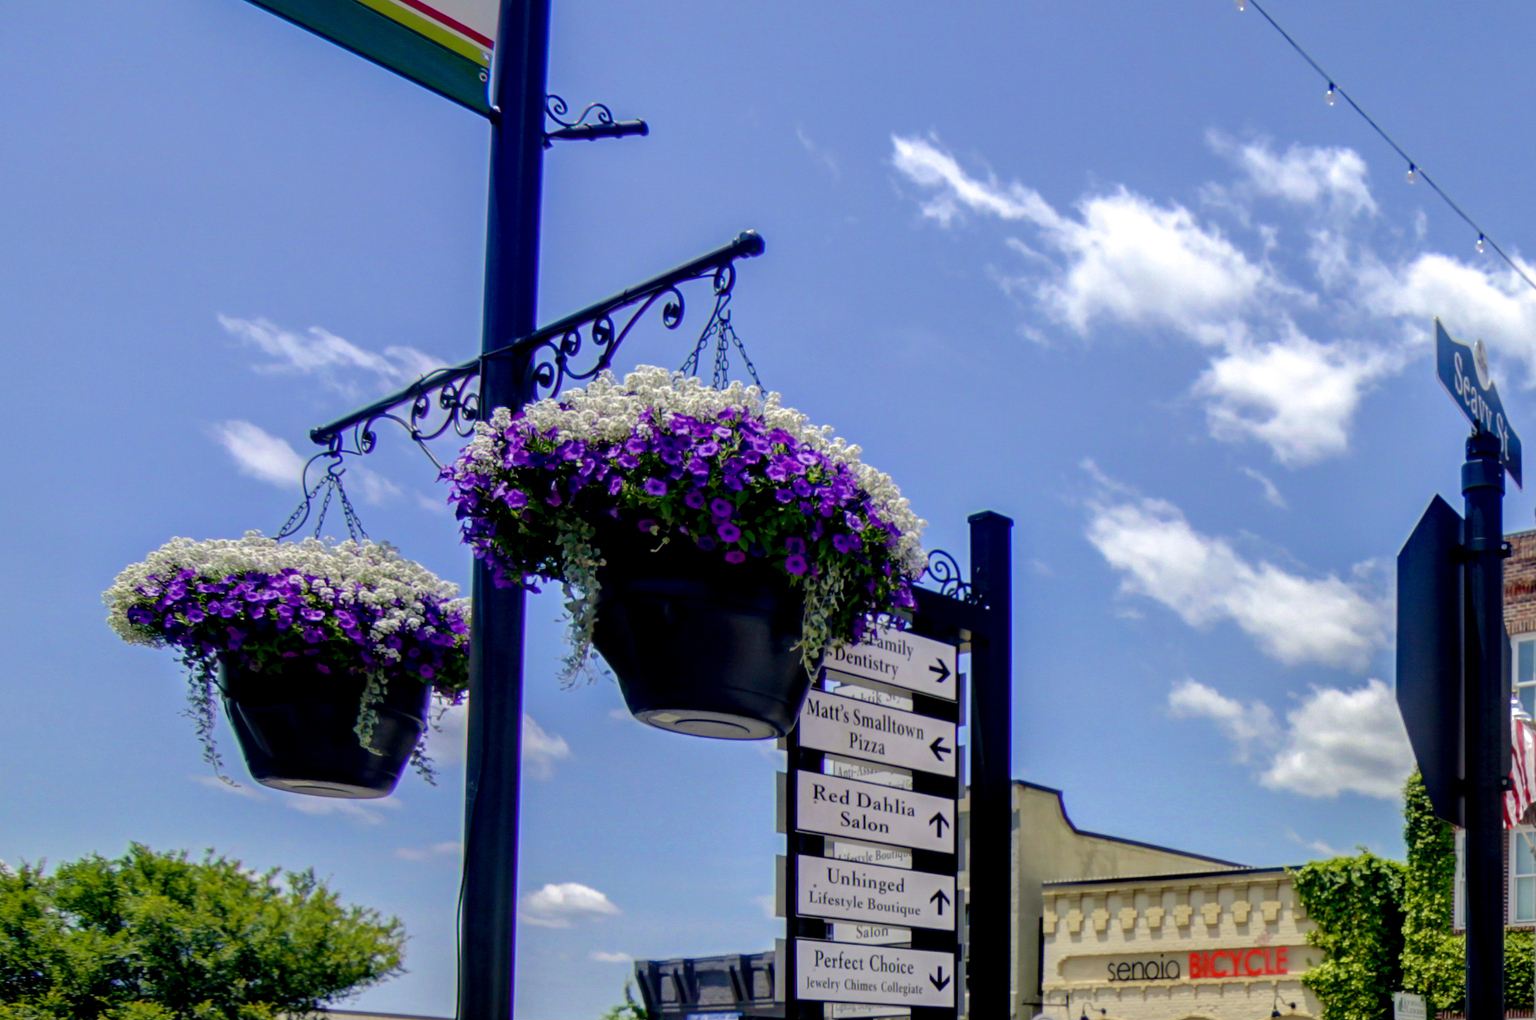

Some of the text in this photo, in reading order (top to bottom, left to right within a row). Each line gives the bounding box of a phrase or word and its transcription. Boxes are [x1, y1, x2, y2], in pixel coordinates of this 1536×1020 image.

[1454, 352, 1510, 461] Seavy St
[869, 633, 914, 661] Family
[835, 646, 899, 680] Dentistry
[806, 698, 924, 740] Matt's Smalltown
[849, 731, 885, 755] Pizza
[812, 783, 915, 817] Red Dahlia
[840, 811, 890, 834] Salon
[827, 867, 905, 895] Unhinged
[809, 890, 921, 918] Lifestyle Boutique
[855, 925, 889, 939] Salon
[814, 949, 914, 975] Perfect Choice
[1107, 947, 1289, 982] senoia BICYCLE
[806, 976, 923, 997] Jewelry Chimes Collegiate
